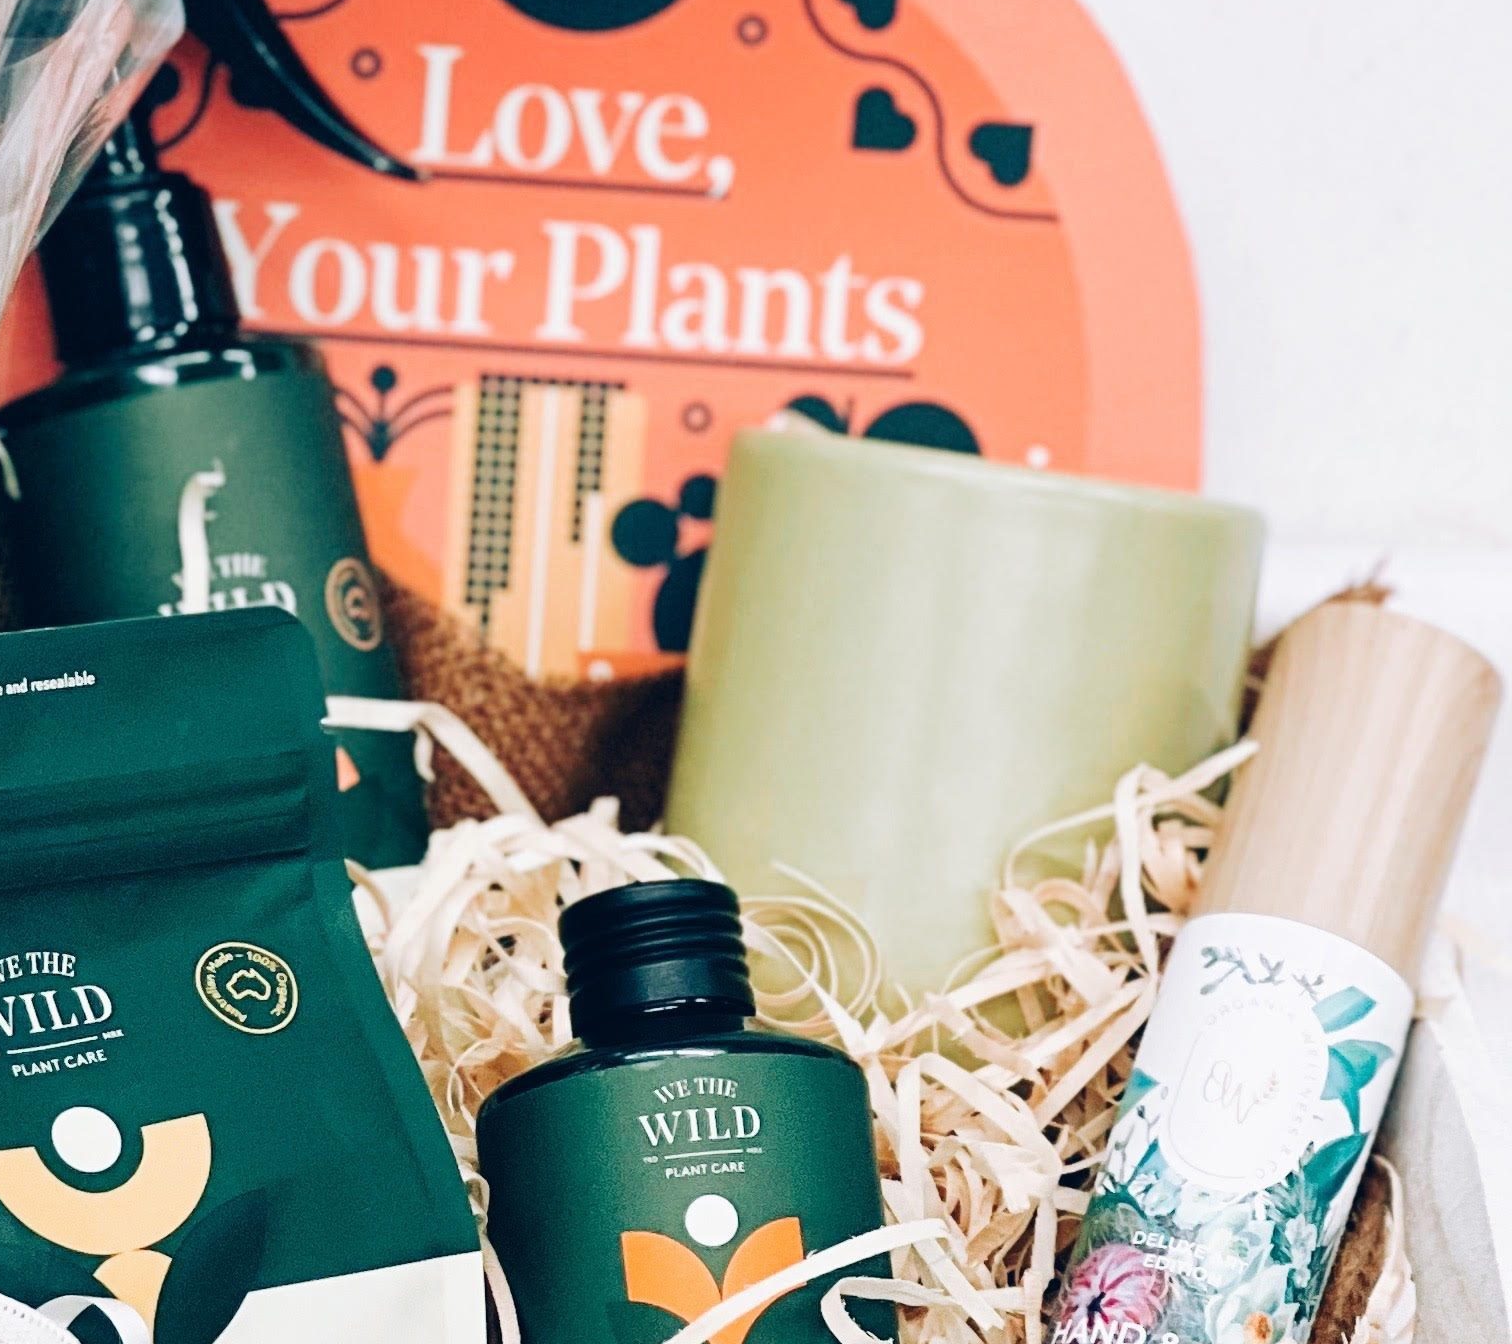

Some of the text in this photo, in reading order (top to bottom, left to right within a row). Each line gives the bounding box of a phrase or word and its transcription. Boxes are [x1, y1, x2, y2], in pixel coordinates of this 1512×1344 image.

[411, 43, 736, 200] Love,
[213, 199, 927, 366] Your Plants
[6, 677, 28, 695] and
[31, 670, 96, 692] resealable
[26, 951, 76, 978] THE
[11, 1049, 108, 1077] PLANT CARE
[653, 1077, 738, 1104] WE THE
[638, 1105, 761, 1146] WILD
[665, 1161, 745, 1179] PLANT CARE
